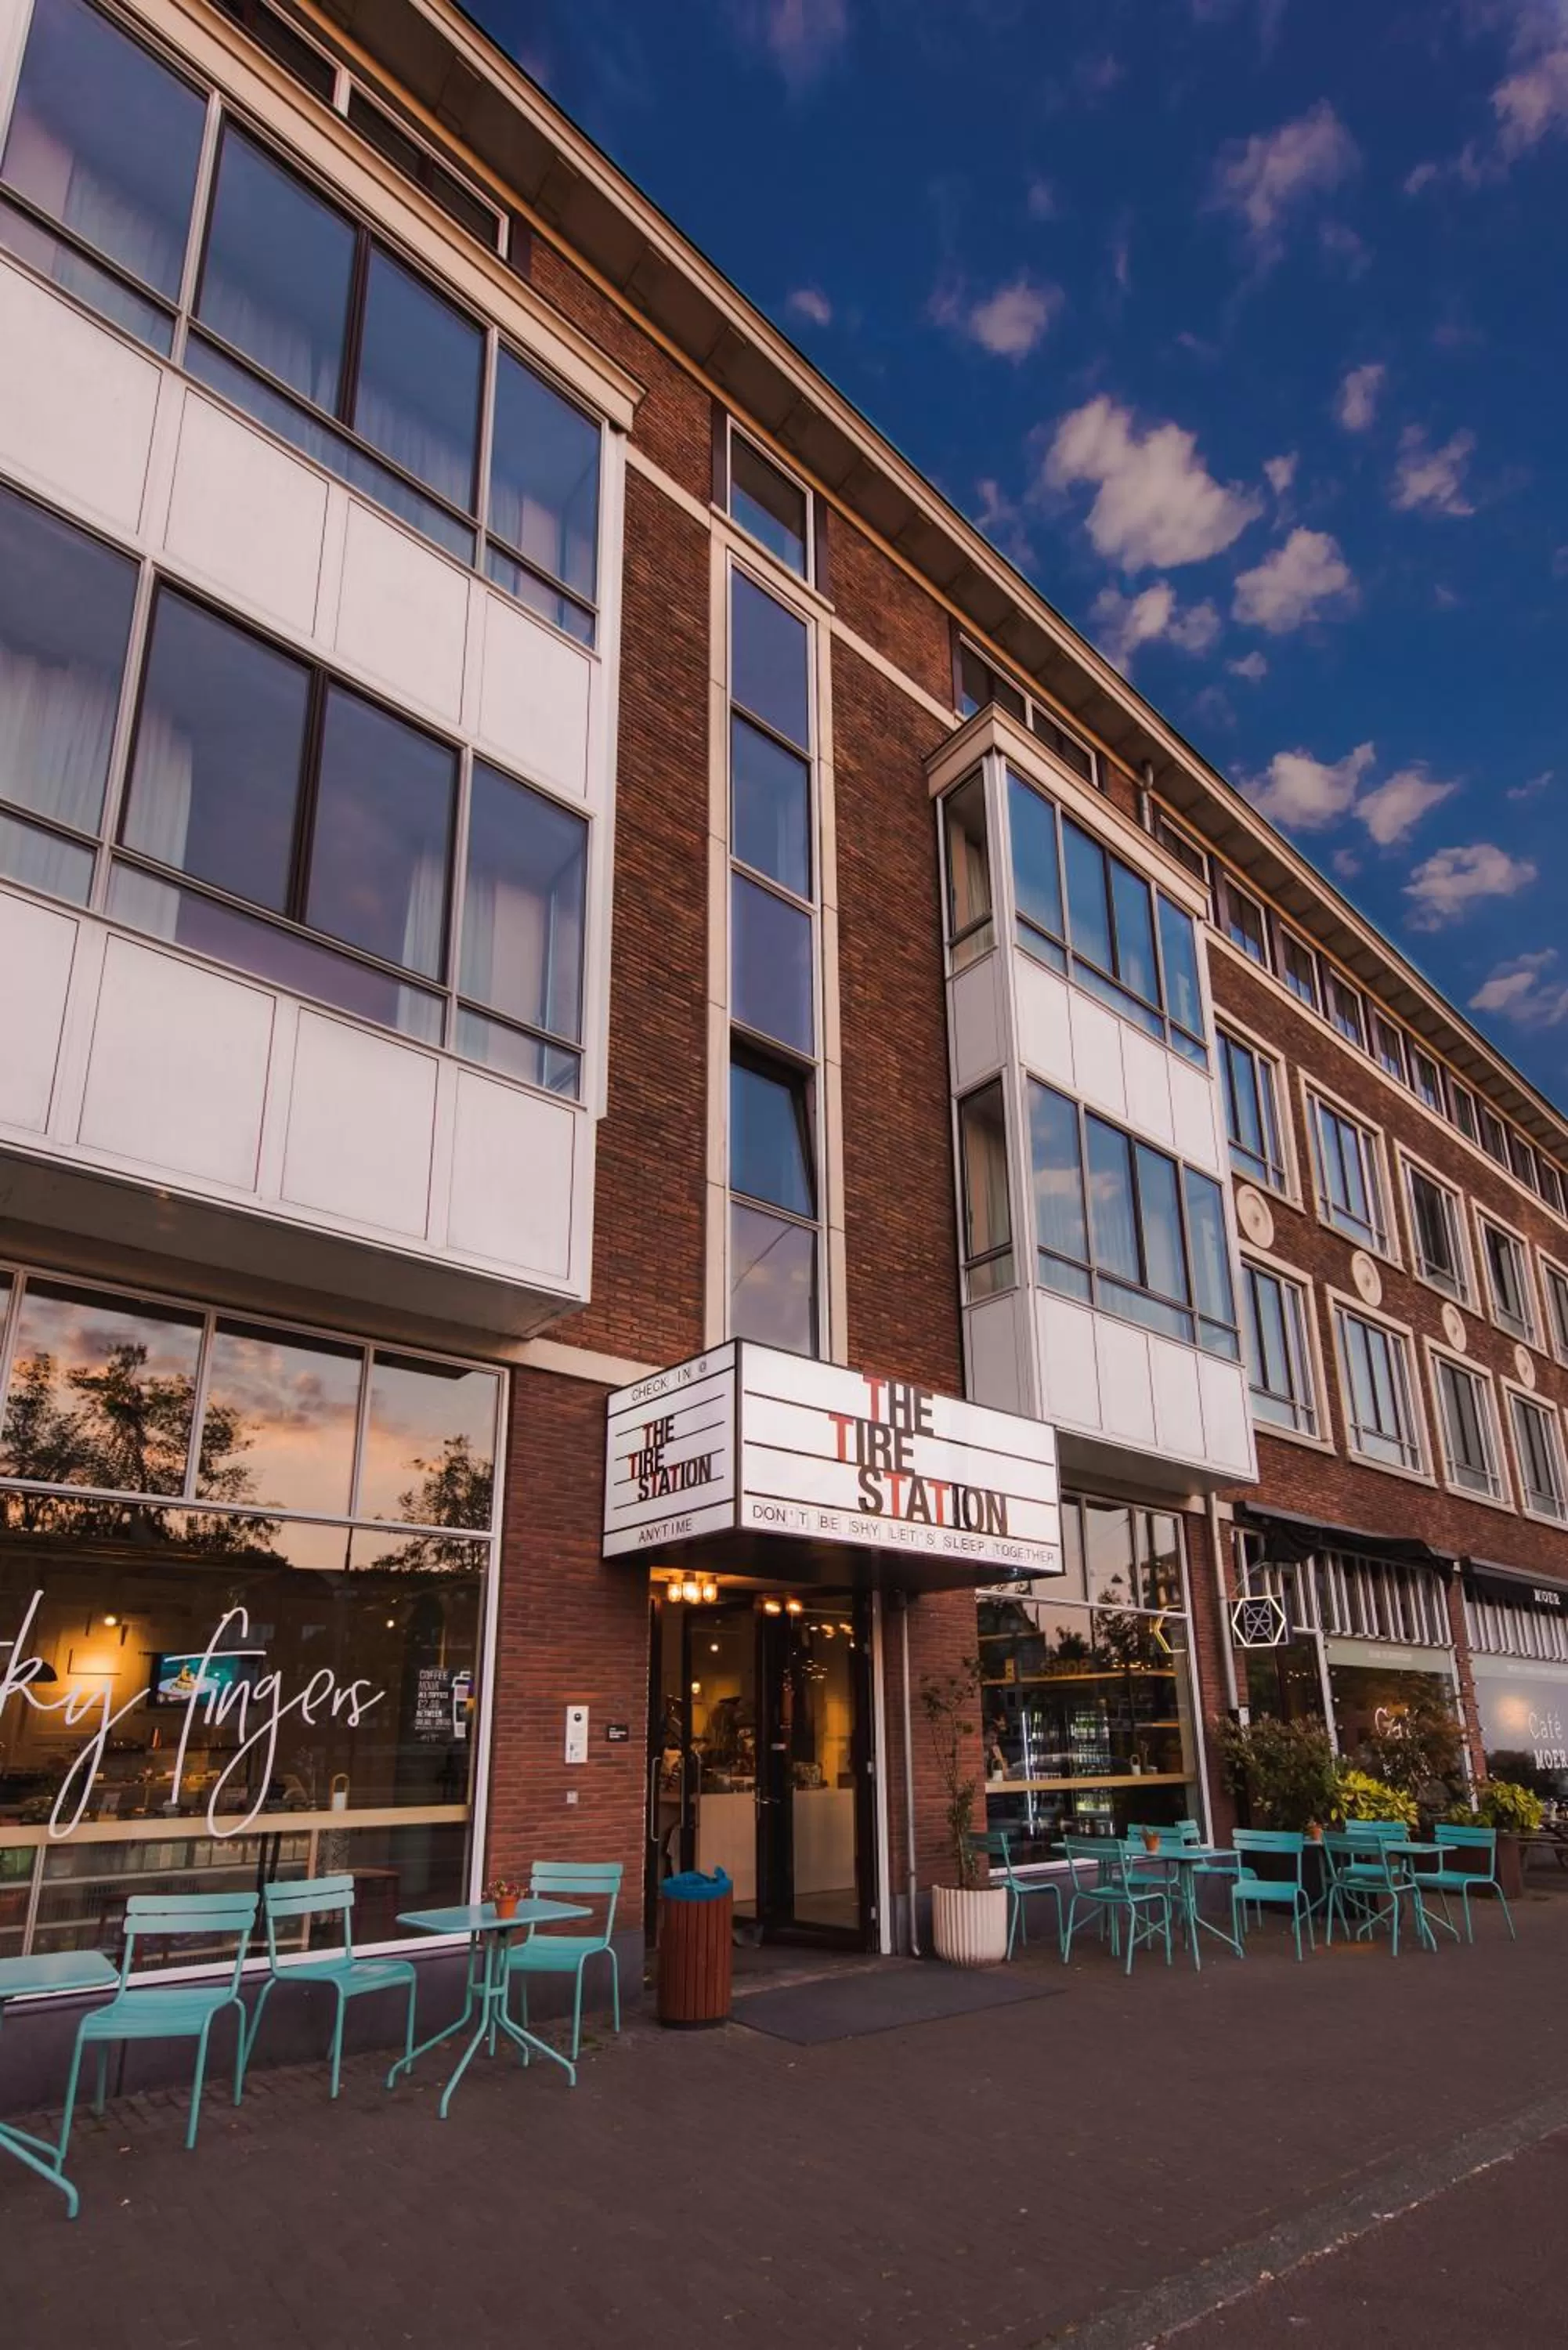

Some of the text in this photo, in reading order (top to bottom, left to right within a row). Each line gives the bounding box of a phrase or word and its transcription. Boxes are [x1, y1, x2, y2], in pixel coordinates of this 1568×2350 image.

[631, 1378, 667, 1401] CHECK
[677, 1368, 691, 1383] IN
[862, 1376, 933, 1435] THE
[642, 1415, 675, 1450] THE
[828, 1412, 916, 1476] TIRE
[628, 1446, 665, 1480] TIRE
[638, 1453, 713, 1502] STATION
[858, 1466, 1009, 1537] STATION
[638, 1518, 693, 1544] ANYTIME
[820, 1515, 839, 1530] BE
[851, 1521, 878, 1536] SHY
[943, 1535, 985, 1553] SLEEP
[995, 1543, 1054, 1563] TOGETHER
[419, 1670, 448, 1680] COFFEE
[0, 1590, 385, 1838] ky fingers
[1529, 1712, 1563, 1740] Café
